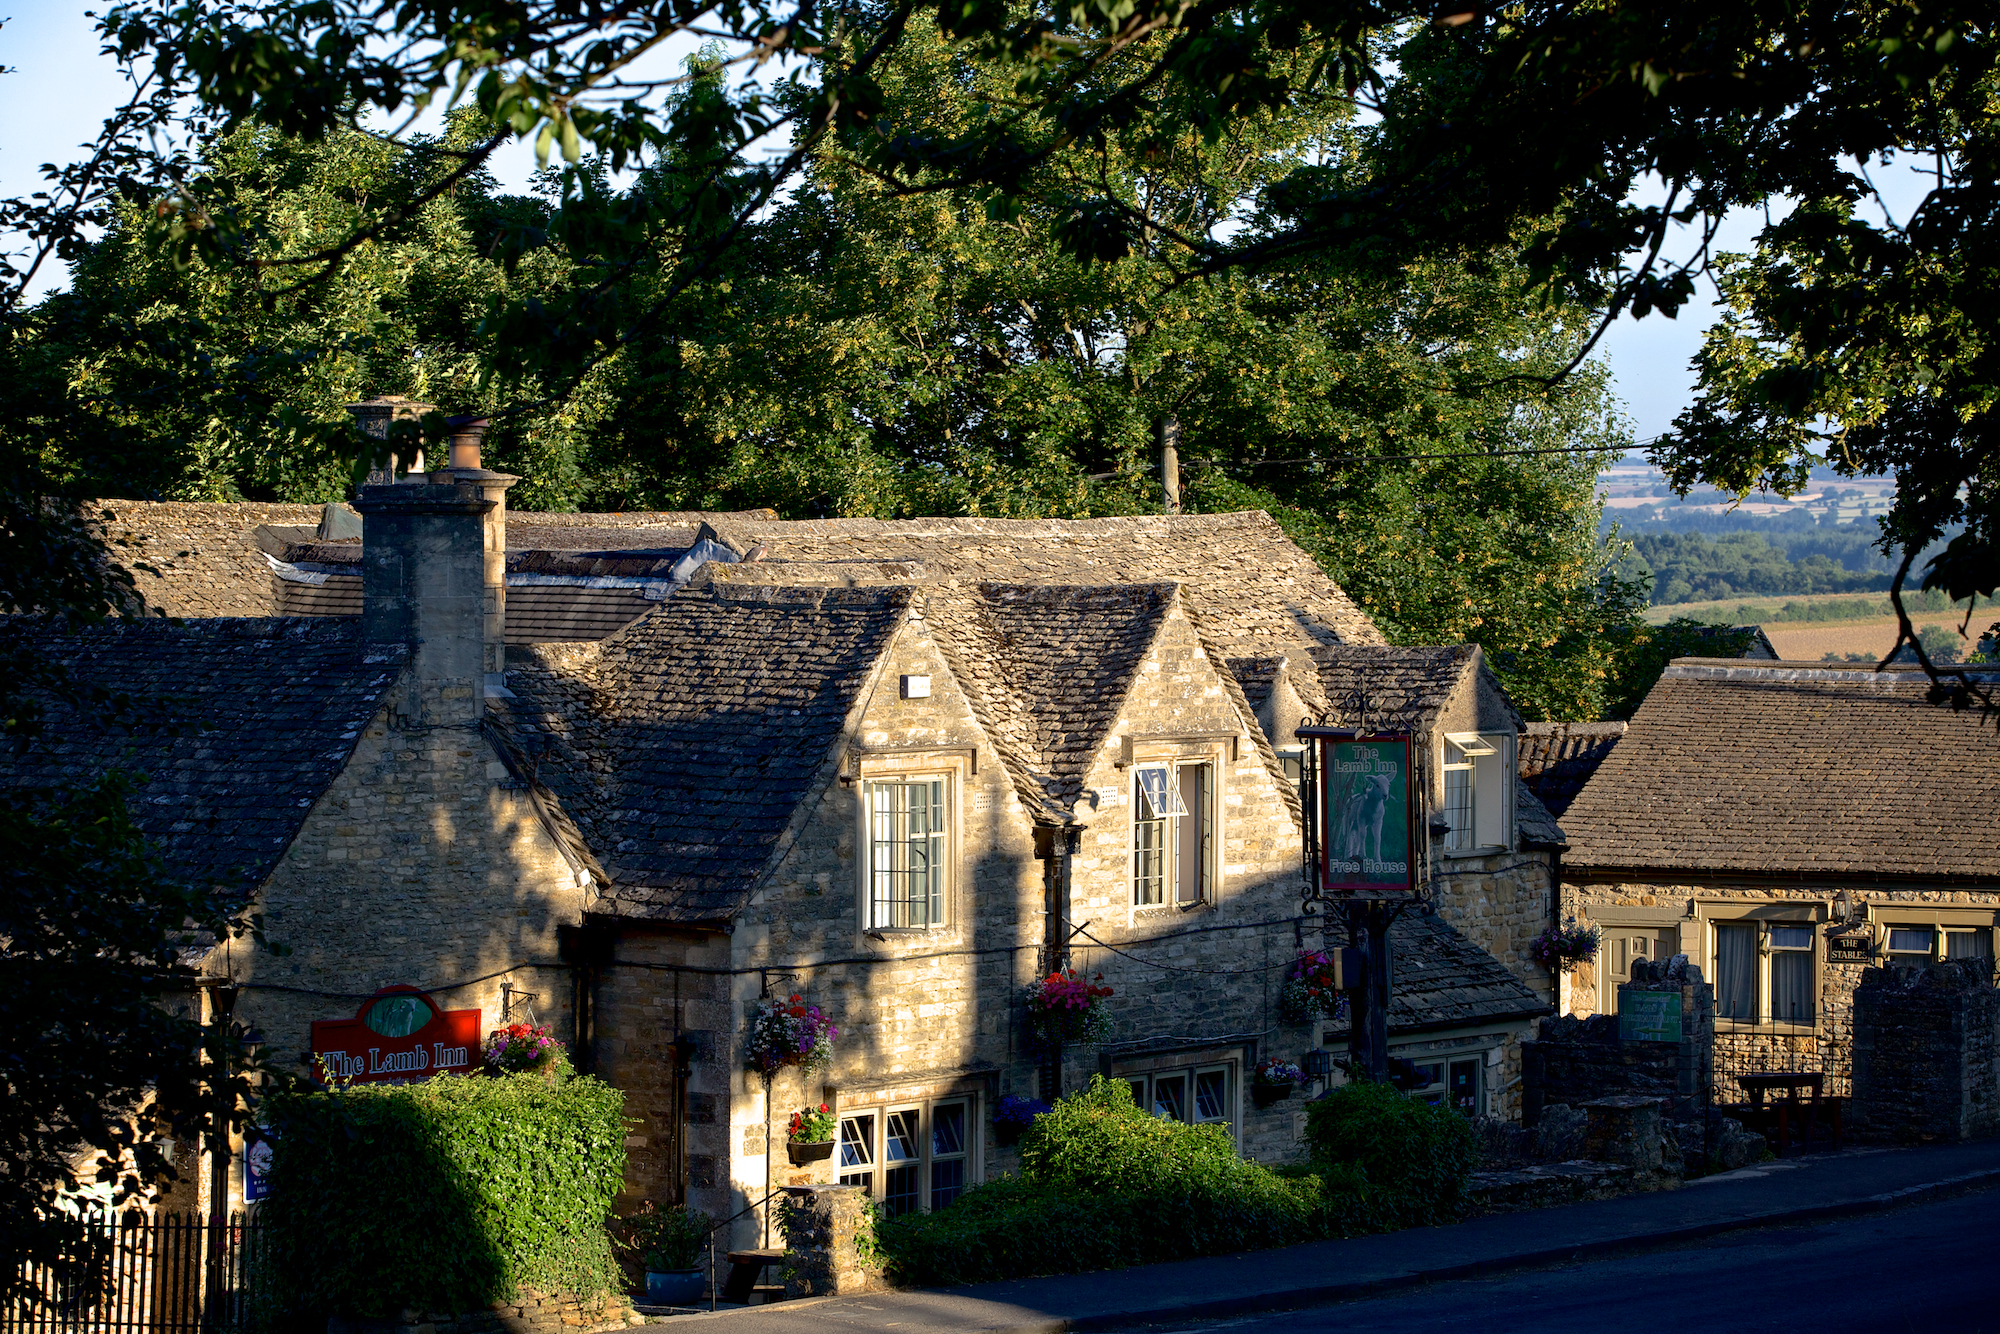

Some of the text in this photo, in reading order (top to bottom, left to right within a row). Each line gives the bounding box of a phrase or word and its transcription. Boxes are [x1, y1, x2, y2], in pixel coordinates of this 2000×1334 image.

[1352, 745, 1379, 760] The
[1334, 758, 1398, 773] Lamb Inn
[1329, 858, 1407, 874] Free House
[1840, 939, 1858, 948] THE
[1832, 950, 1868, 959] STABLES
[323, 1042, 469, 1077] The Lamb Inn
